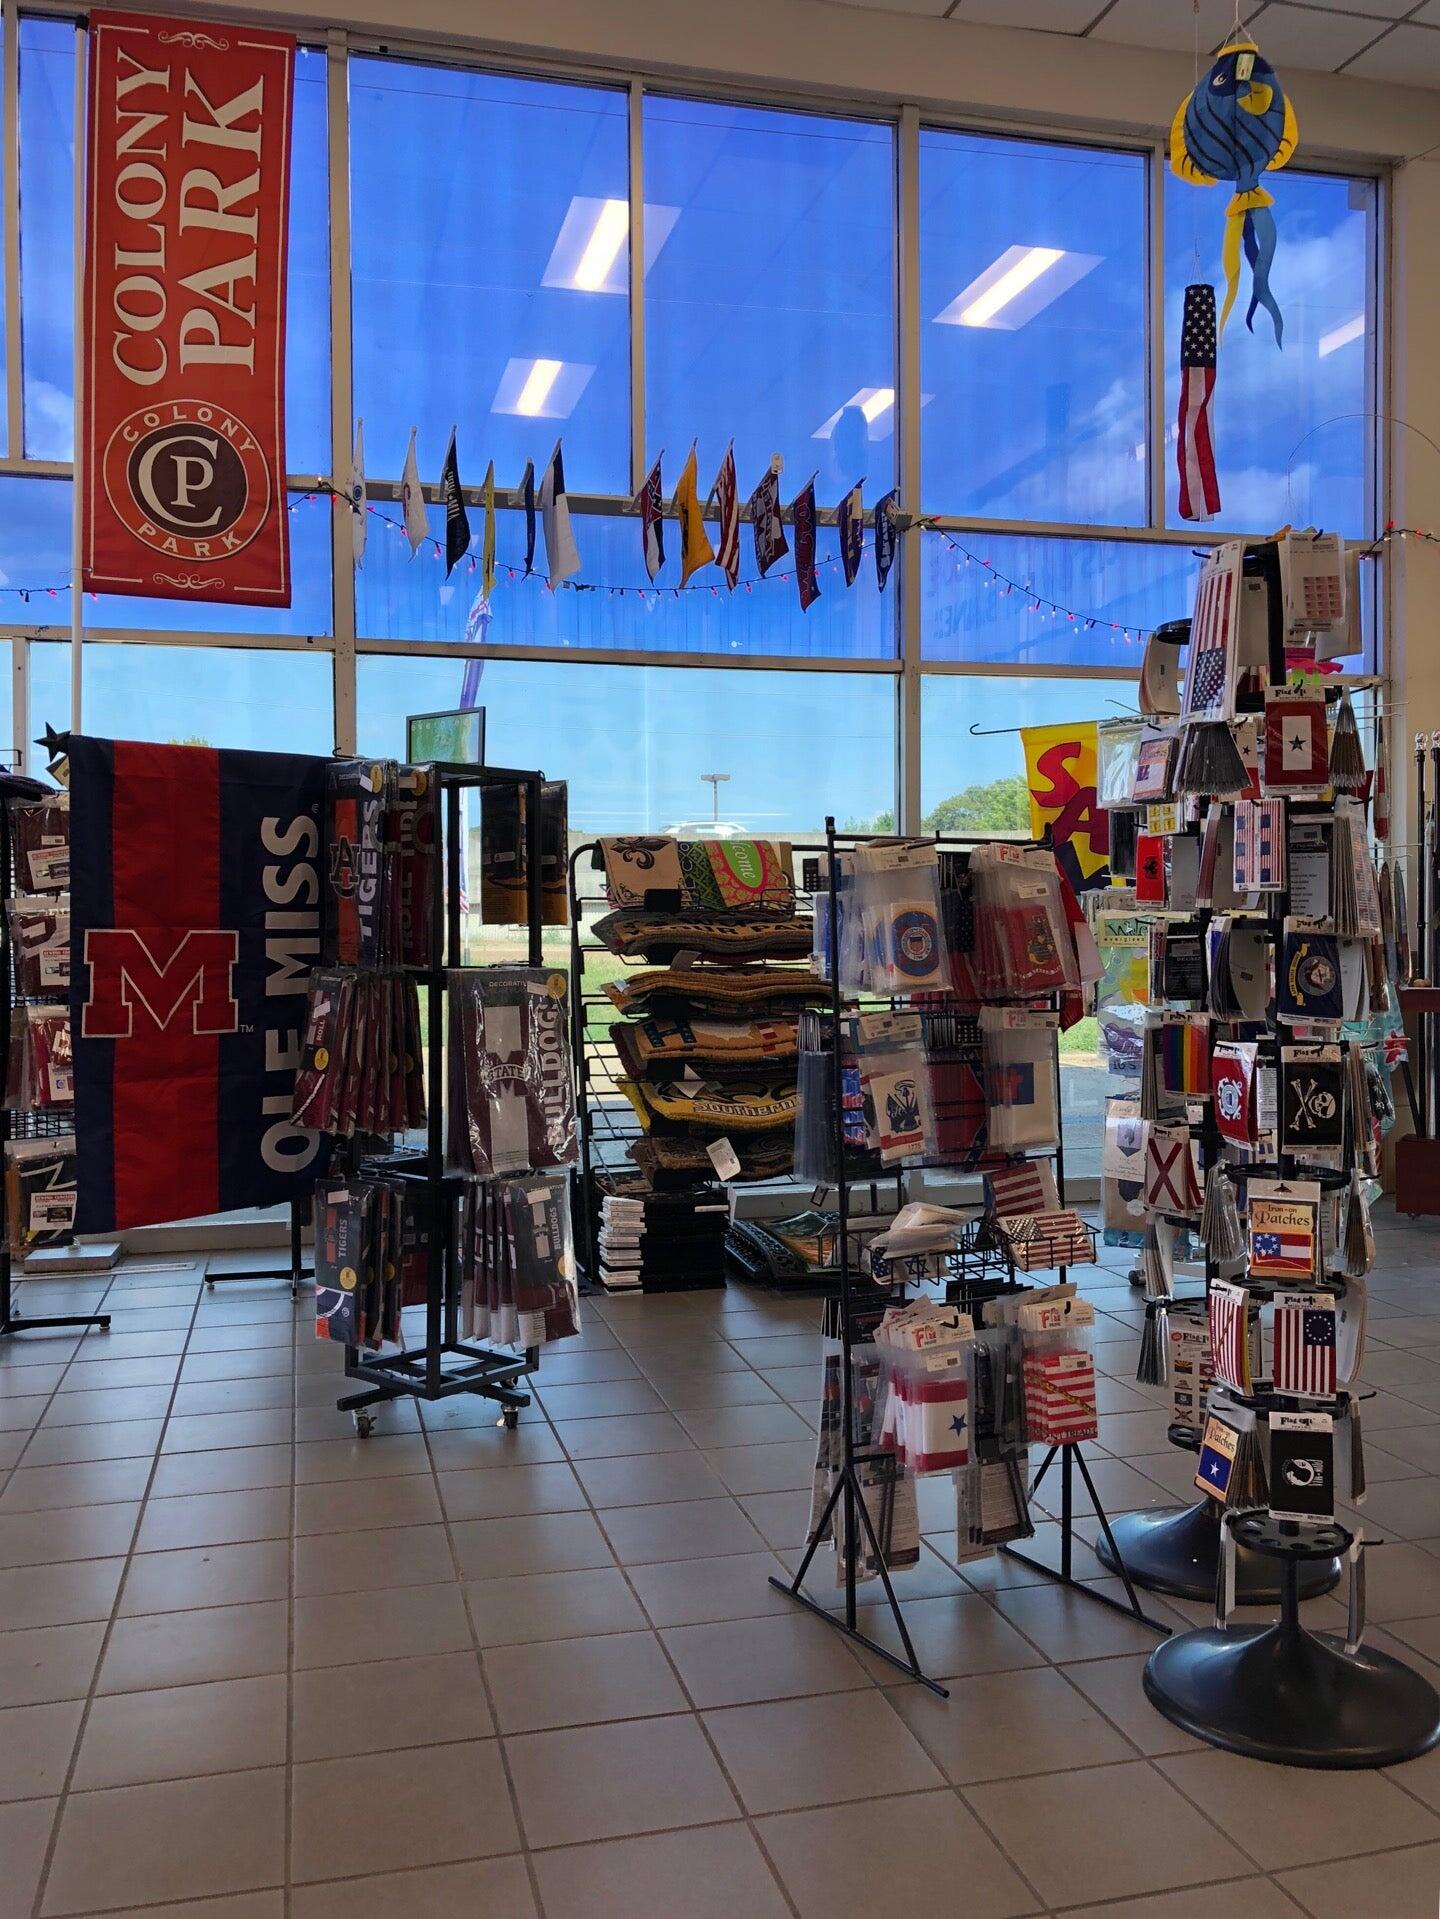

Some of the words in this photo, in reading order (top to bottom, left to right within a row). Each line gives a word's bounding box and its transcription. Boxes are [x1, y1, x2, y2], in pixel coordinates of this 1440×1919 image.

[112, 47, 172, 386] COLONY
[177, 65, 265, 376] PARK
[123, 406, 255, 451] COLONY
[137, 522, 242, 557] PARK
[358, 799, 379, 942] TIGERS
[260, 815, 321, 997] MISS
[82, 928, 240, 1038] M
[489, 980, 527, 988] DECORATIV
[488, 1065, 524, 1082] STATE
[338, 1218, 348, 1258] TIGERS
[550, 1207, 561, 1250] BULLDOGS
[1255, 1210, 1310, 1227] Patches
